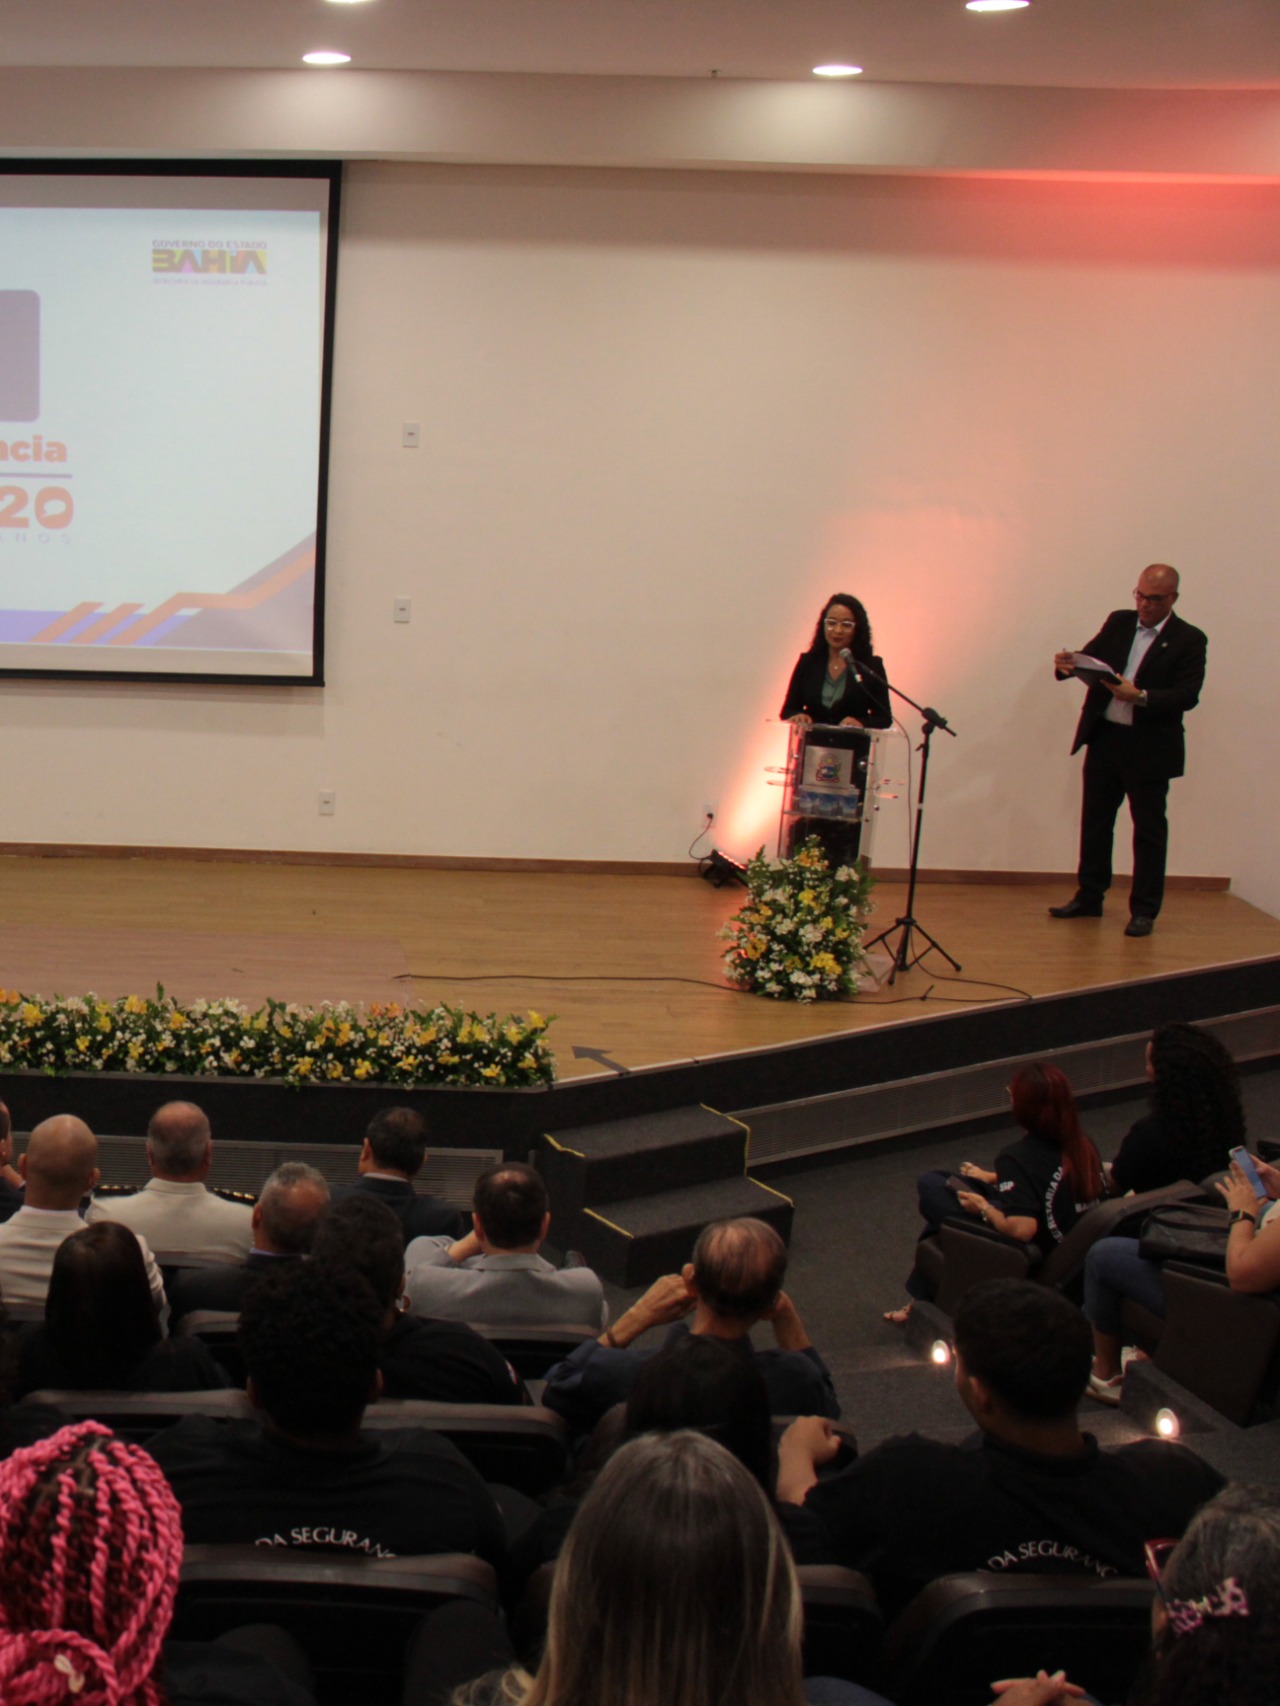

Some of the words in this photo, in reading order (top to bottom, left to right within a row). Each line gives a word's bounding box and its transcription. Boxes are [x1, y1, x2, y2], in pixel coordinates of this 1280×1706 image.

[152, 239, 205, 249] GOVERNO
[208, 240, 223, 249] DO
[226, 240, 267, 249] ESTADO
[152, 249, 267, 275] BAHIA
[987, 1550, 1018, 1570] DA
